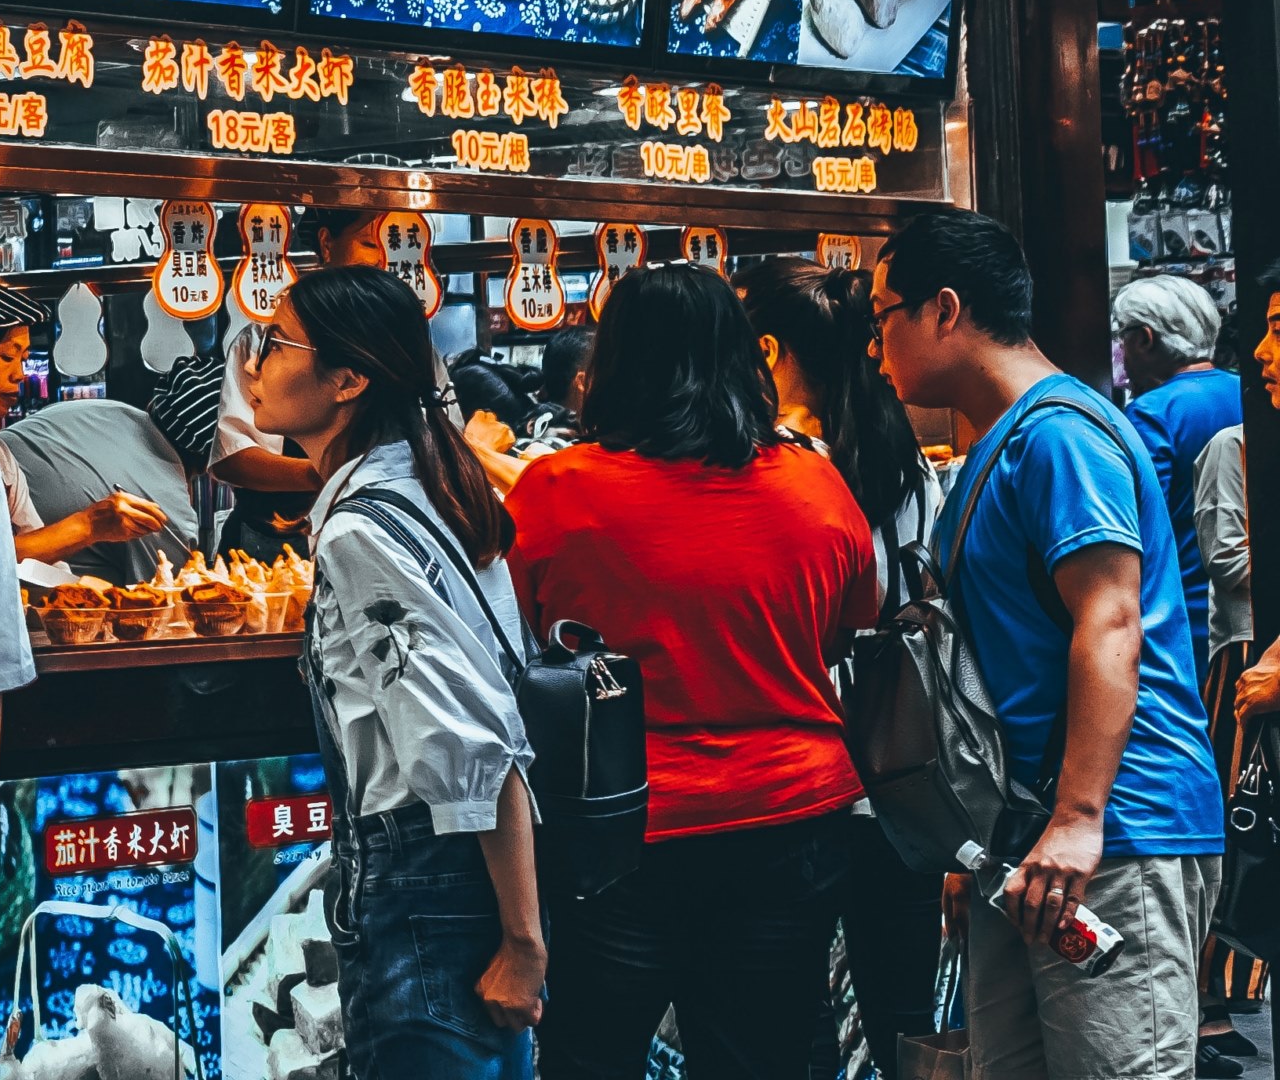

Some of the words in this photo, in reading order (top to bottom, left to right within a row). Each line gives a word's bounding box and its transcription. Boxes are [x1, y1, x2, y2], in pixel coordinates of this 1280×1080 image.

[143, 36, 354, 104] 茄汁香米大虾
[408, 58, 569, 128] 香脆玉米棒
[618, 75, 731, 142] 香酥里脊
[208, 110, 296, 154] 18元/客
[765, 94, 918, 155] 火山岩石烤肠
[452, 130, 530, 172] 10元/根
[641, 141, 711, 182] 10元/串
[812, 156, 877, 193] 15元/串
[172, 220, 205, 245] 香炸
[251, 216, 283, 244] 茄汁
[387, 222, 422, 252] 泰式
[172, 250, 208, 278] 臭豆腐
[172, 286, 209, 303] 10元/客
[272, 800, 329, 839] 臭豆
[53, 821, 190, 867] 茄汁香米大虾
[273, 849, 322, 865] Stinky
